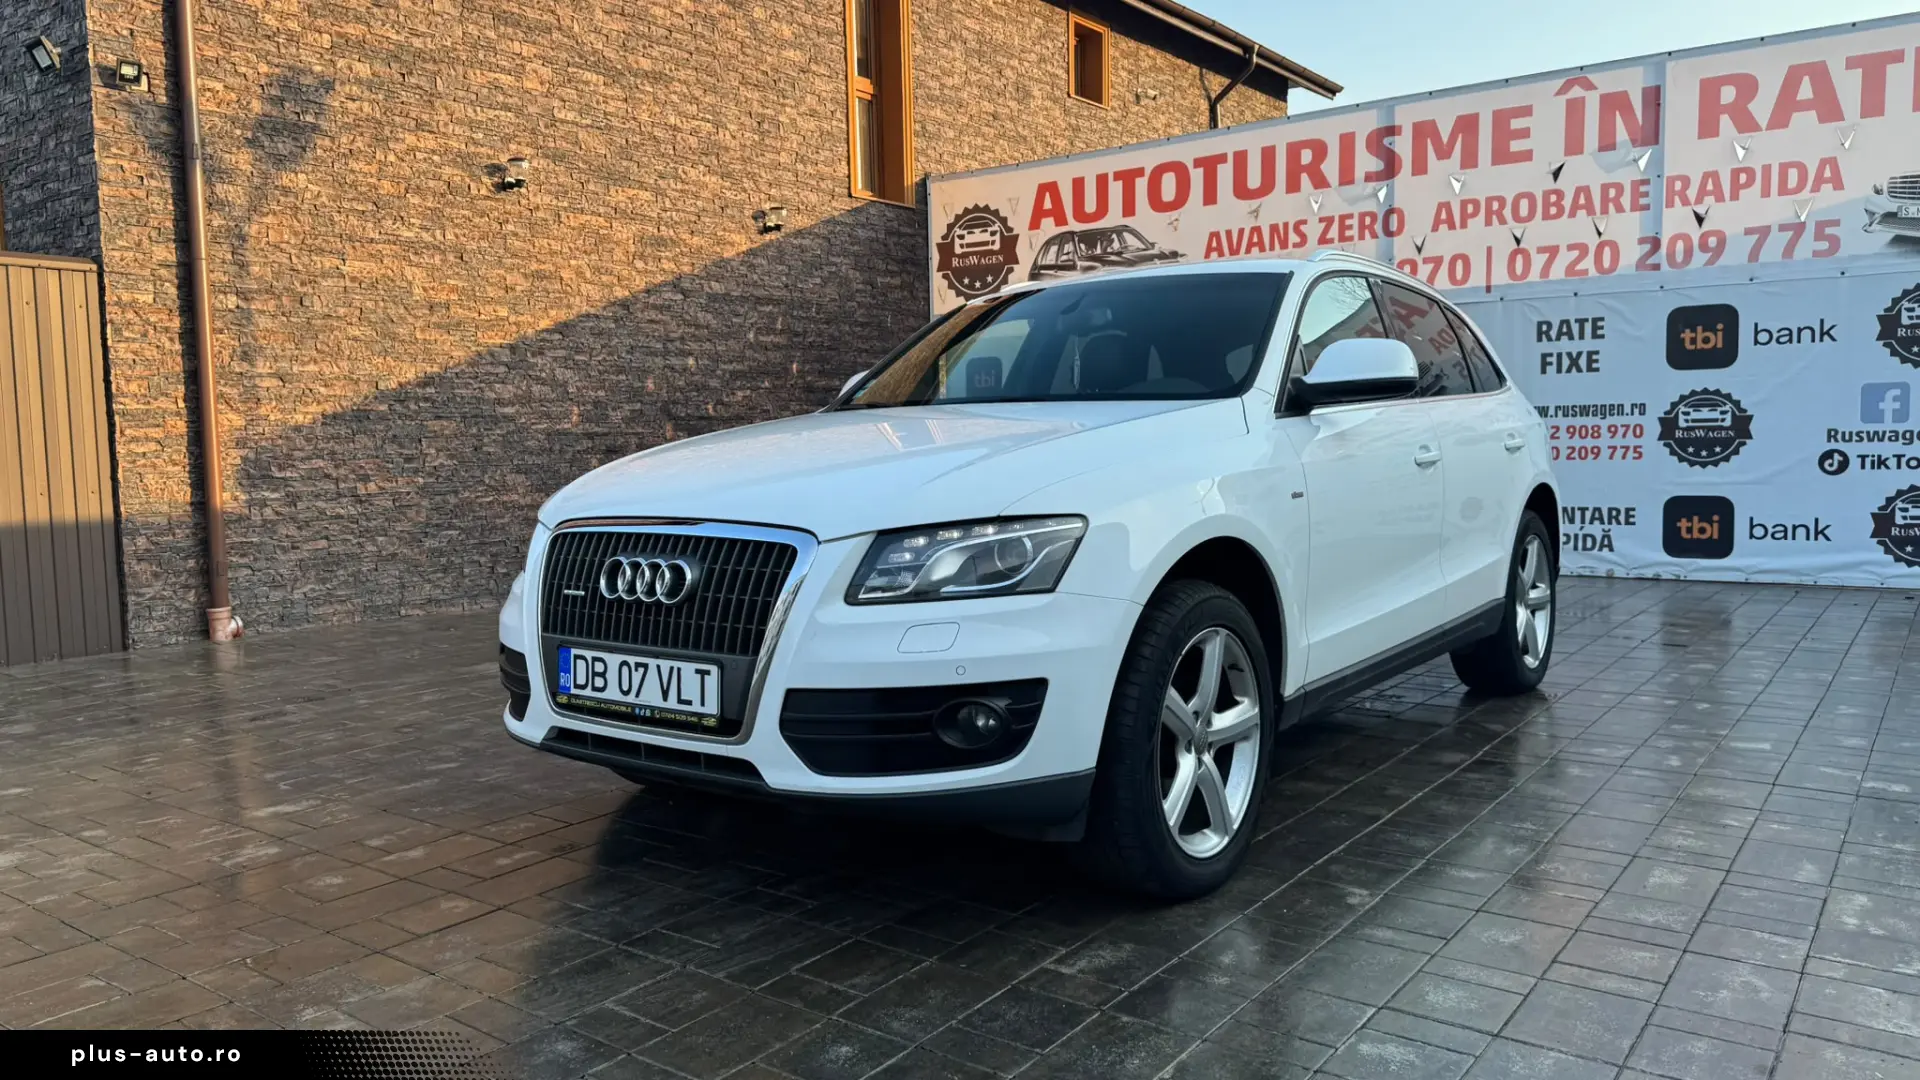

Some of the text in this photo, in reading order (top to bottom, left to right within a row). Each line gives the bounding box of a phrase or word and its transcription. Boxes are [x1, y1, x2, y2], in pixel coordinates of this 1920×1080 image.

[1028, 104, 1534, 231] AUTOTURISME
[1553, 75, 1662, 157] ÎN
[1203, 155, 1845, 260] AVANS ZERO APROBARE RAPIDA
[1506, 239, 1621, 283] 0720
[1635, 229, 1727, 272] 209
[1742, 218, 1841, 264] 775
[1536, 316, 1605, 343] RATE
[1680, 318, 1838, 350] tbi bank
[1539, 350, 1600, 375] FIXE
[1534, 403, 1646, 420] w.ruswagen.ro
[1566, 424, 1602, 439] 908
[1607, 423, 1644, 439] 970
[1565, 446, 1602, 460] 209
[1607, 445, 1643, 460] 775
[1562, 528, 1615, 552] PIDĂ
[1676, 515, 1832, 542] tbi bank
[560, 673, 571, 687] RO
[573, 654, 711, 707] DB 07 VLT
